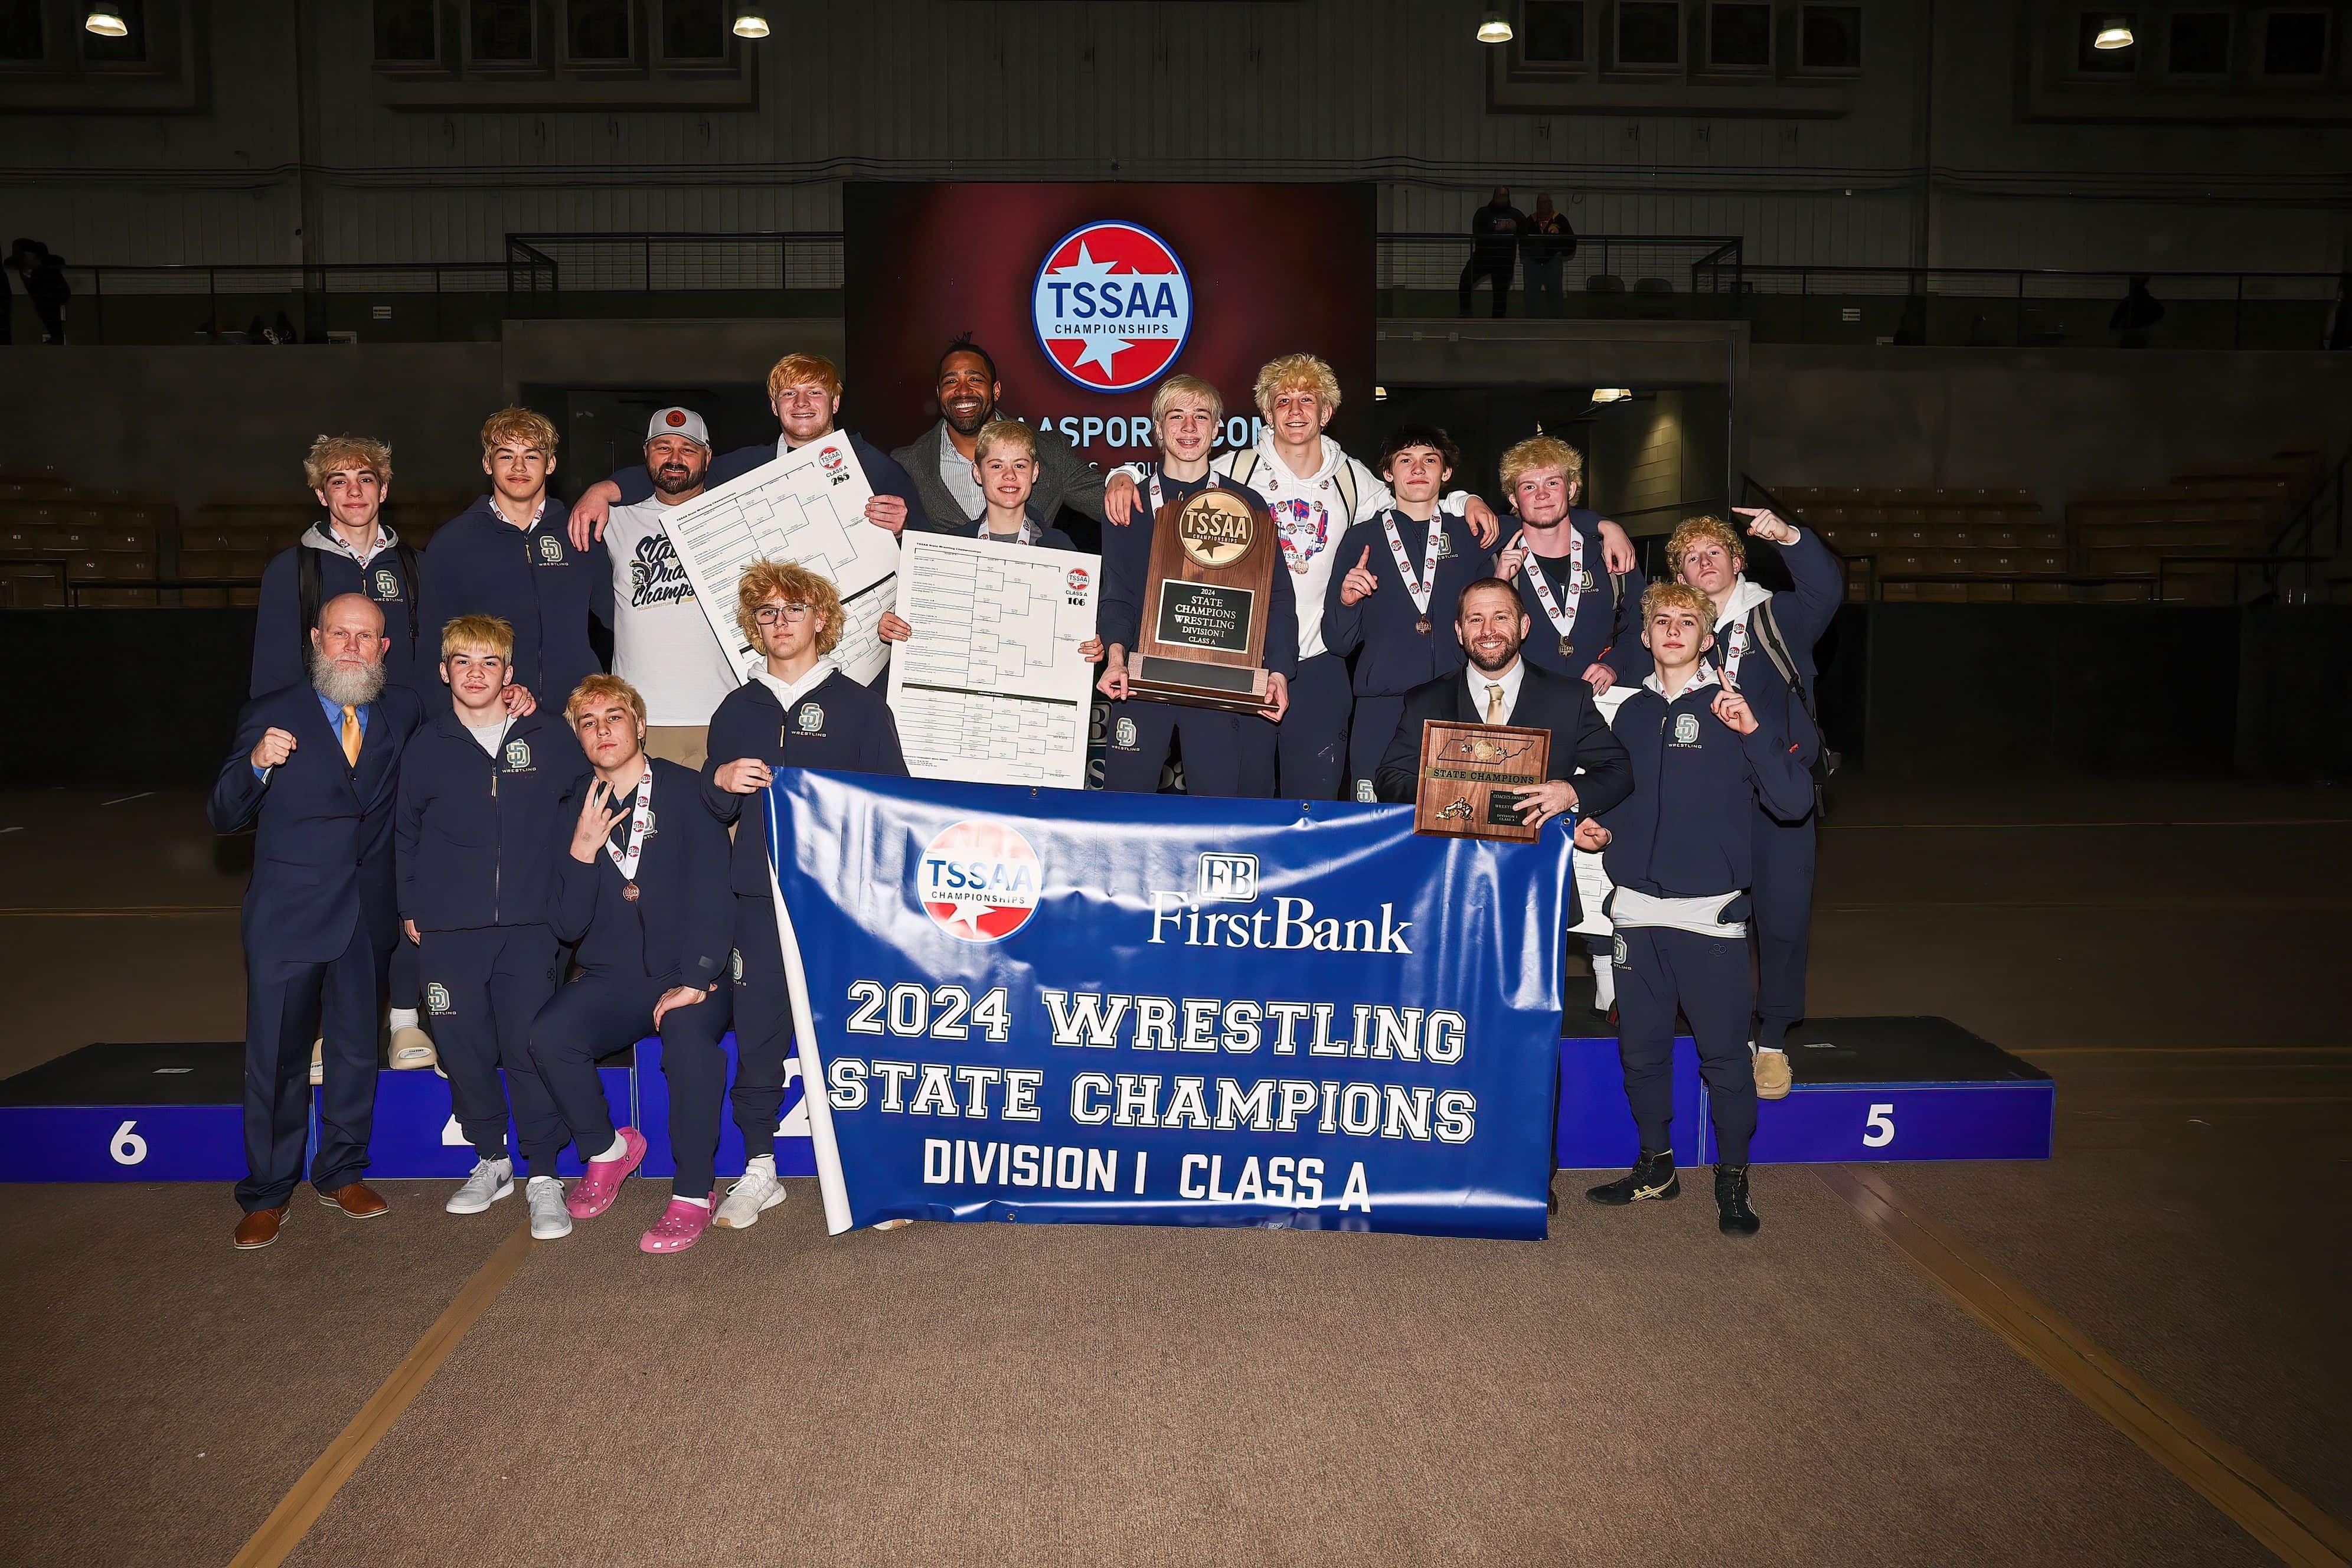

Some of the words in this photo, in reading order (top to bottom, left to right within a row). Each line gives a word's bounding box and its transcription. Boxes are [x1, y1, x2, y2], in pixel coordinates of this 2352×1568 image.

[1047, 282, 1178, 318] TSSAA
[1054, 324, 1168, 334] CHAMPIONSHIPS
[821, 452, 840, 463] TSSAA
[826, 468, 842, 477] CLASS
[831, 473, 850, 486] 285
[1186, 511, 1247, 539] TSSAA
[1193, 534, 1237, 543] CHAMPIONSHIPS
[1067, 597, 1085, 606] 106
[1191, 596, 1223, 607] STATE
[1175, 604, 1236, 619] CHAMPIONS
[1174, 614, 1235, 630] WRESTLING
[1182, 626, 1220, 637] DIVISION
[1188, 636, 1210, 644] CLASS
[1461, 744, 1473, 753] 20
[1433, 770, 1466, 779] STATE
[1471, 772, 1535, 785] CHAMPIONS
[927, 860, 1033, 892] TSSAA
[1205, 858, 1251, 895] FB
[932, 891, 1025, 904] CHAMPIONSHIPS
[1146, 890, 1413, 955] FirstBank
[846, 979, 1011, 1043] 2024
[1041, 989, 1466, 1065] WRESTLING
[827, 1057, 1043, 1122] STATE
[1069, 1071, 1476, 1145] CHAMPIONS
[1862, 1103, 1896, 1148] 5
[109, 1120, 148, 1166] 6
[923, 1138, 1118, 1193] DIVISION
[1133, 1152, 1147, 1194] I
[1179, 1154, 1325, 1209] CLASS
[1338, 1161, 1372, 1213] A
